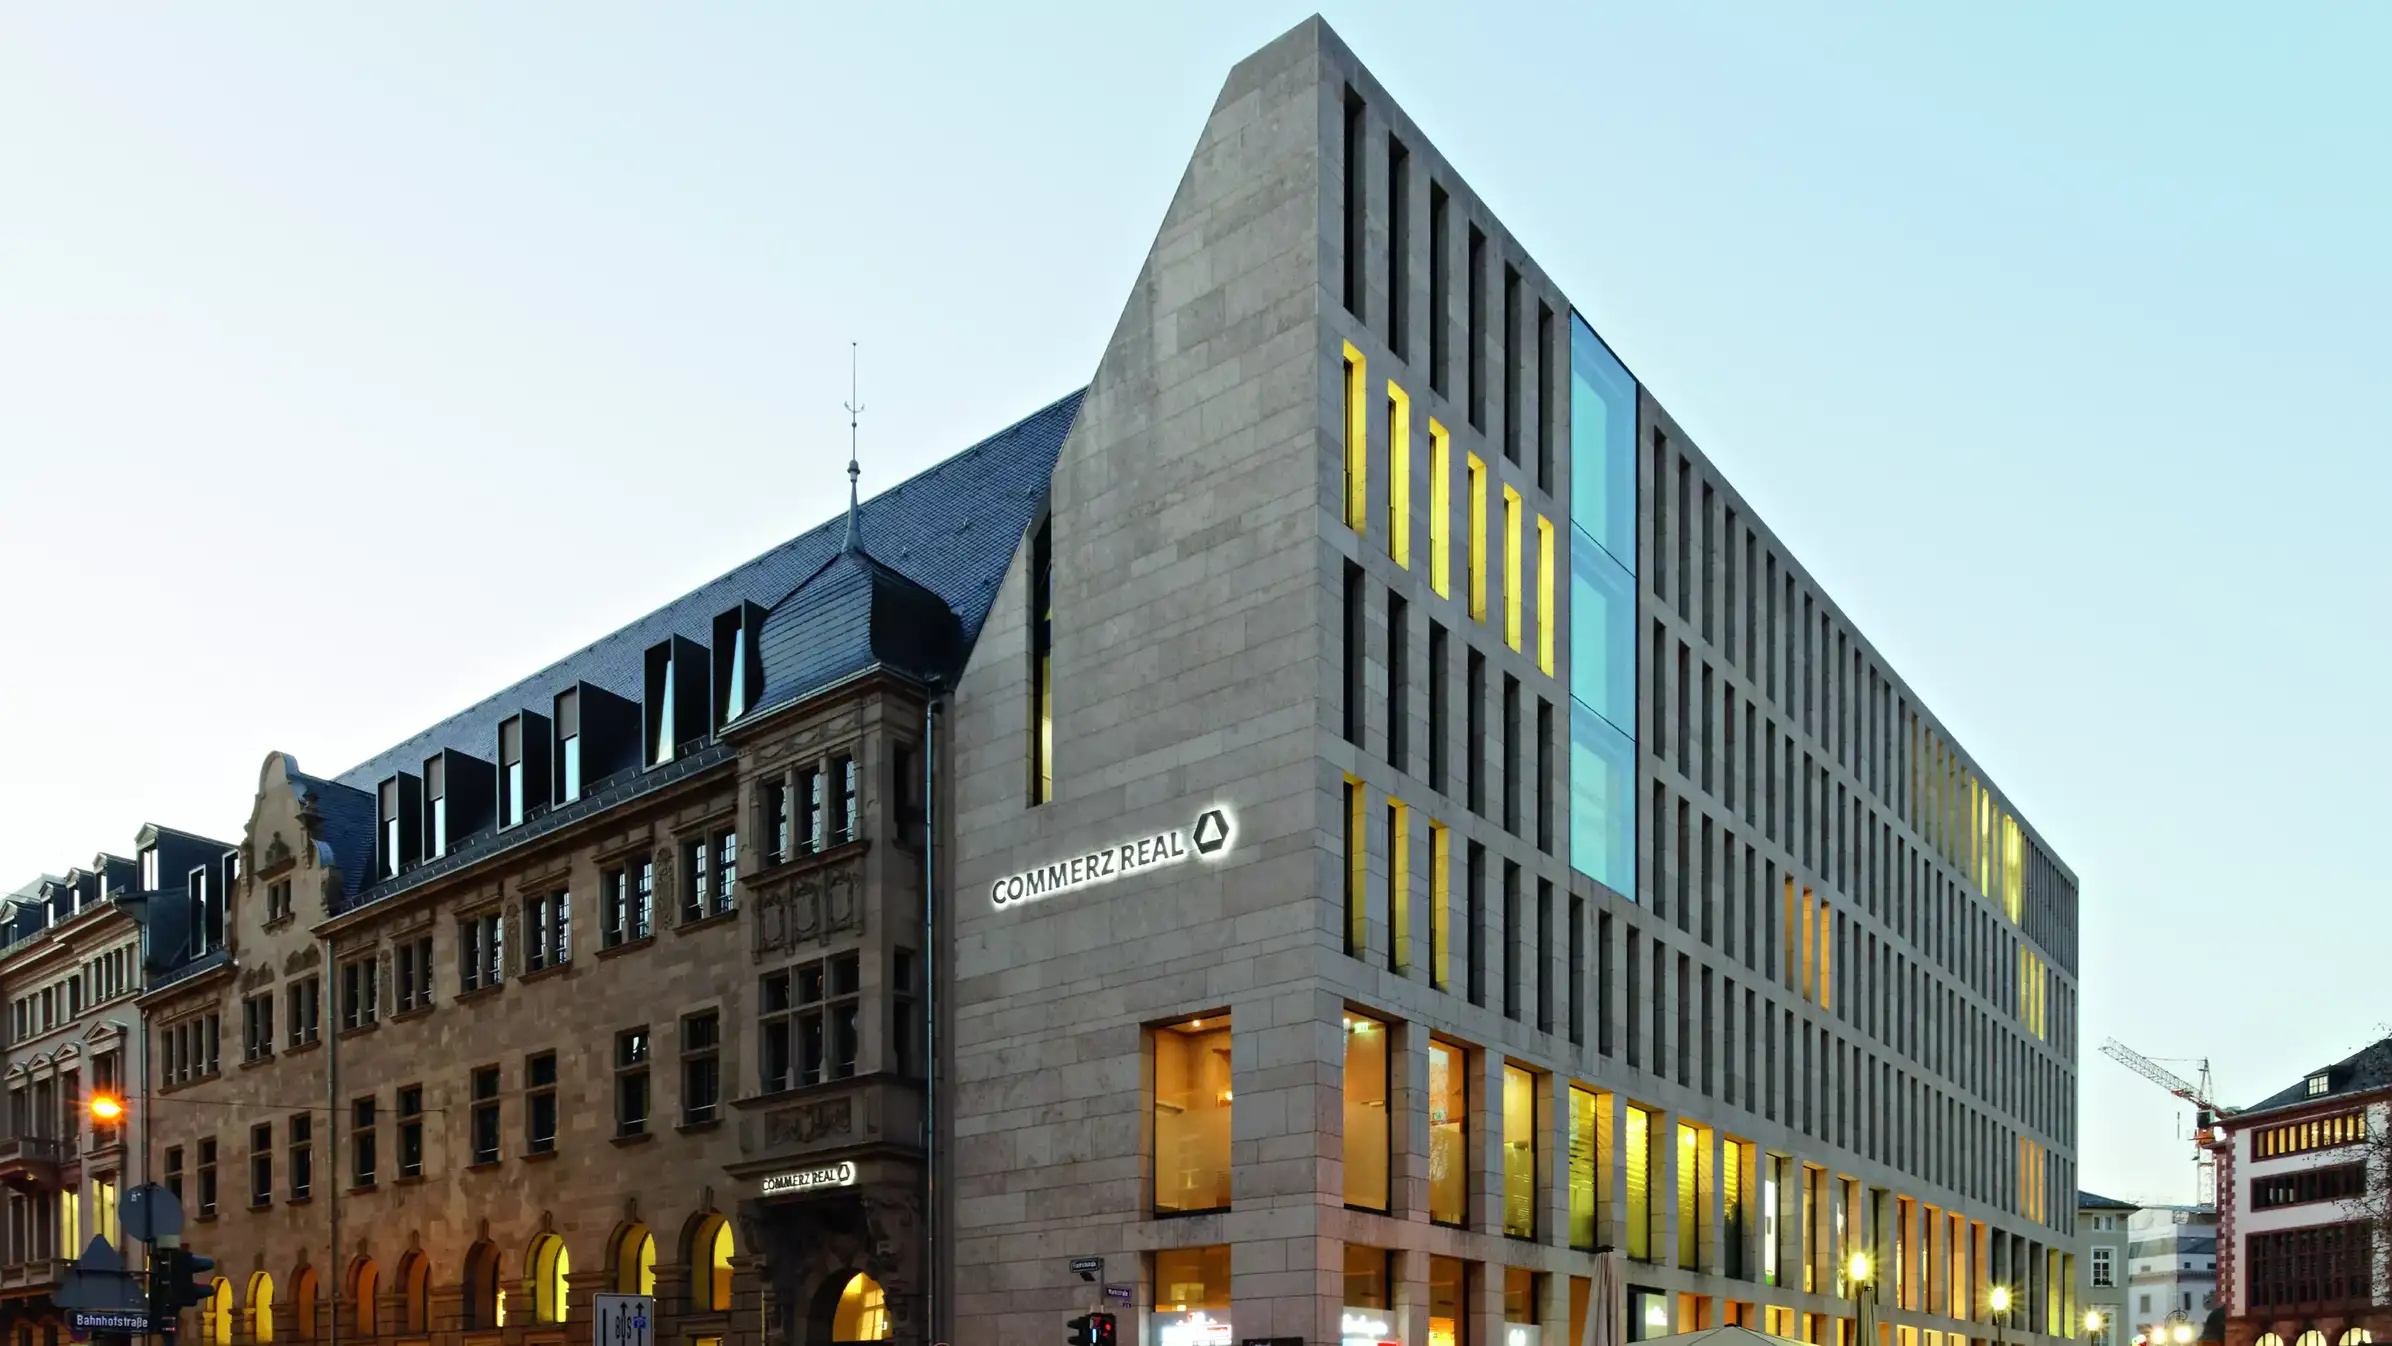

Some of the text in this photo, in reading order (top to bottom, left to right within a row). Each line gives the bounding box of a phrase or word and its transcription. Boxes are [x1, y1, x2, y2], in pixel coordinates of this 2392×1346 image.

[992, 832, 1185, 904] COMMERZ REAL
[762, 1169, 837, 1191] COMMERZ REAL
[76, 1314, 149, 1328] Bahnhofstraße
[615, 1316, 632, 1339] BUS
